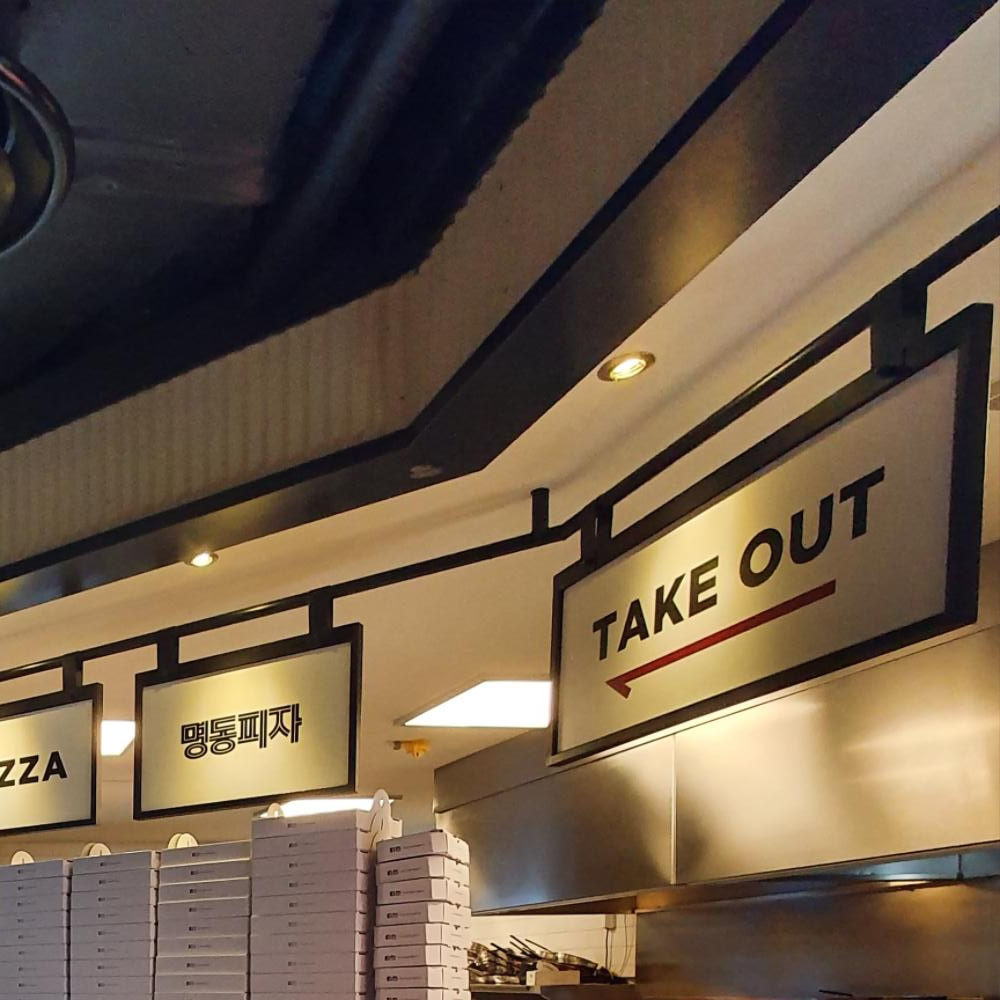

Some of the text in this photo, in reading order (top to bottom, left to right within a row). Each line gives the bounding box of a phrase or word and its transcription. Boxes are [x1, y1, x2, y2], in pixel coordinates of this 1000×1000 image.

[593, 465, 885, 660] TAKE OUT
[180, 703, 302, 759] 명동피자
